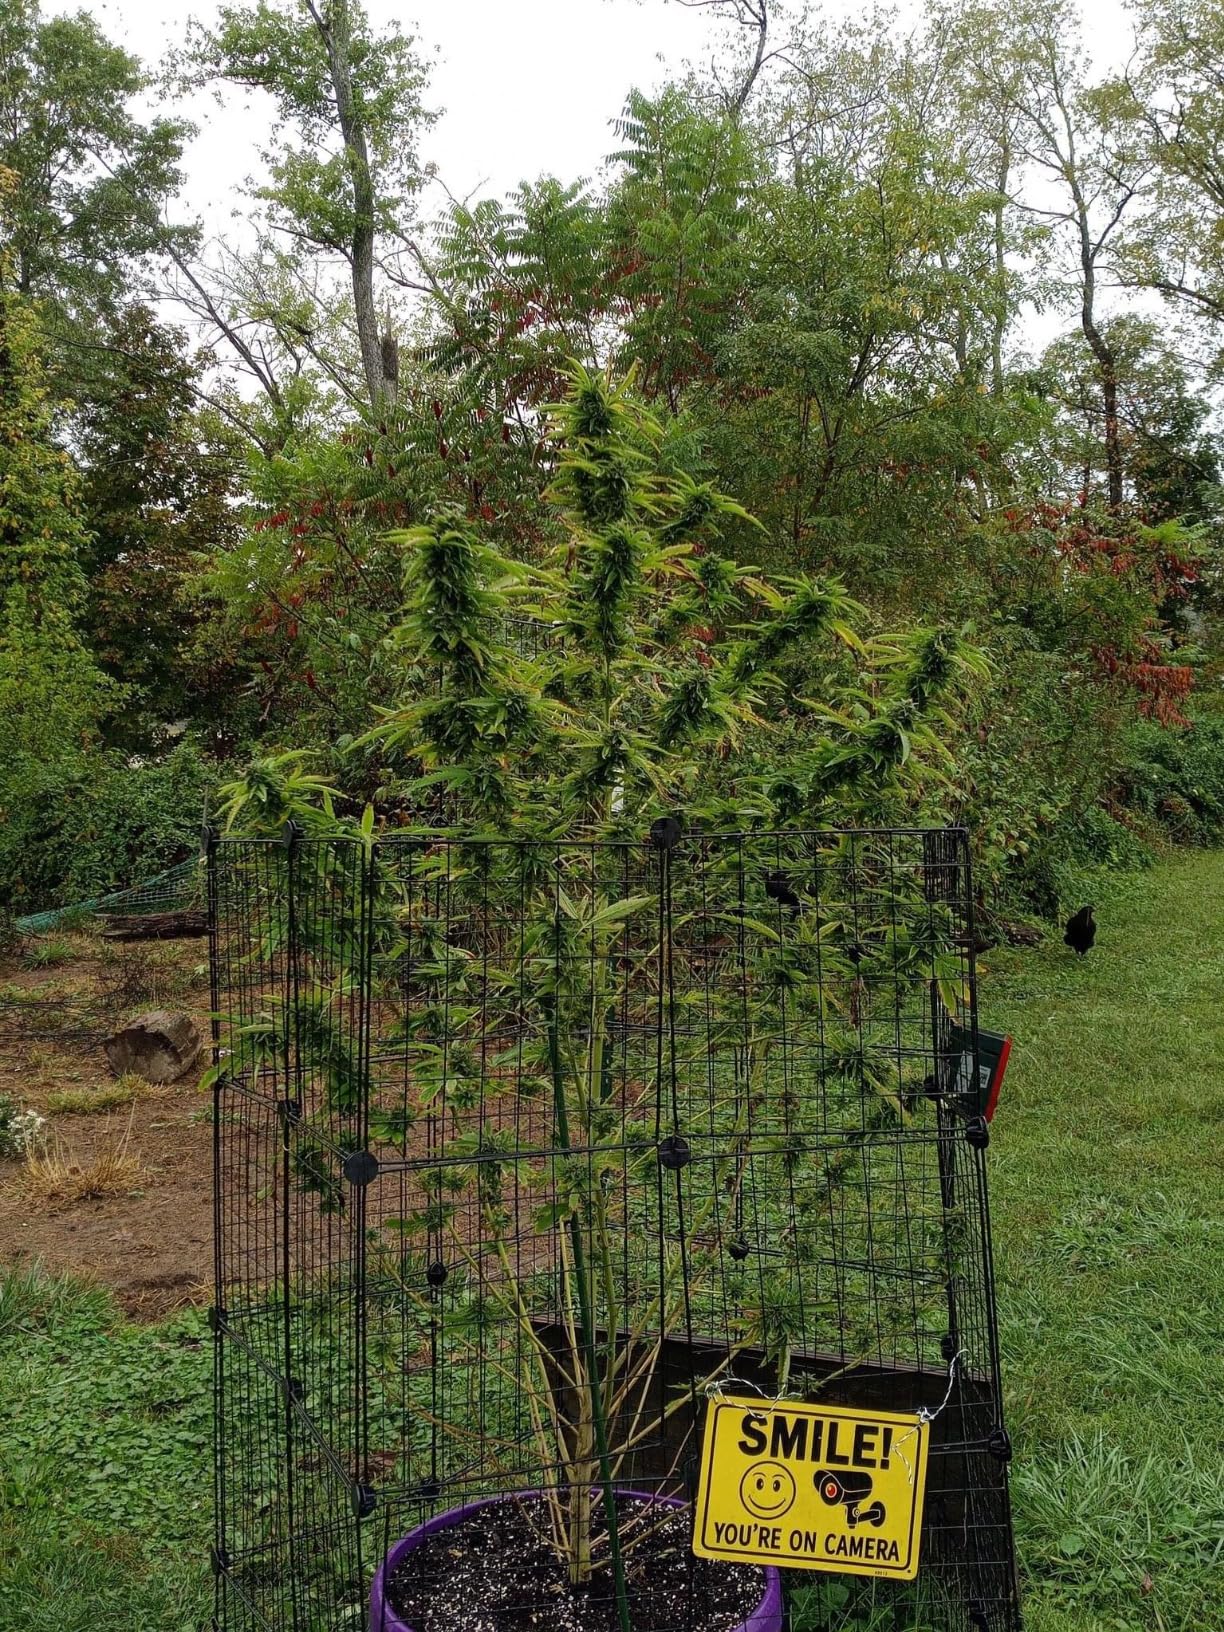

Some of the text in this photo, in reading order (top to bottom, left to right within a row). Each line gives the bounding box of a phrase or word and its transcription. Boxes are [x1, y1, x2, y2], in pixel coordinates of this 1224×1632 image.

[738, 1413, 893, 1470] SMILE!
[714, 1522, 900, 1562] YOU'RE ON CAMERA
